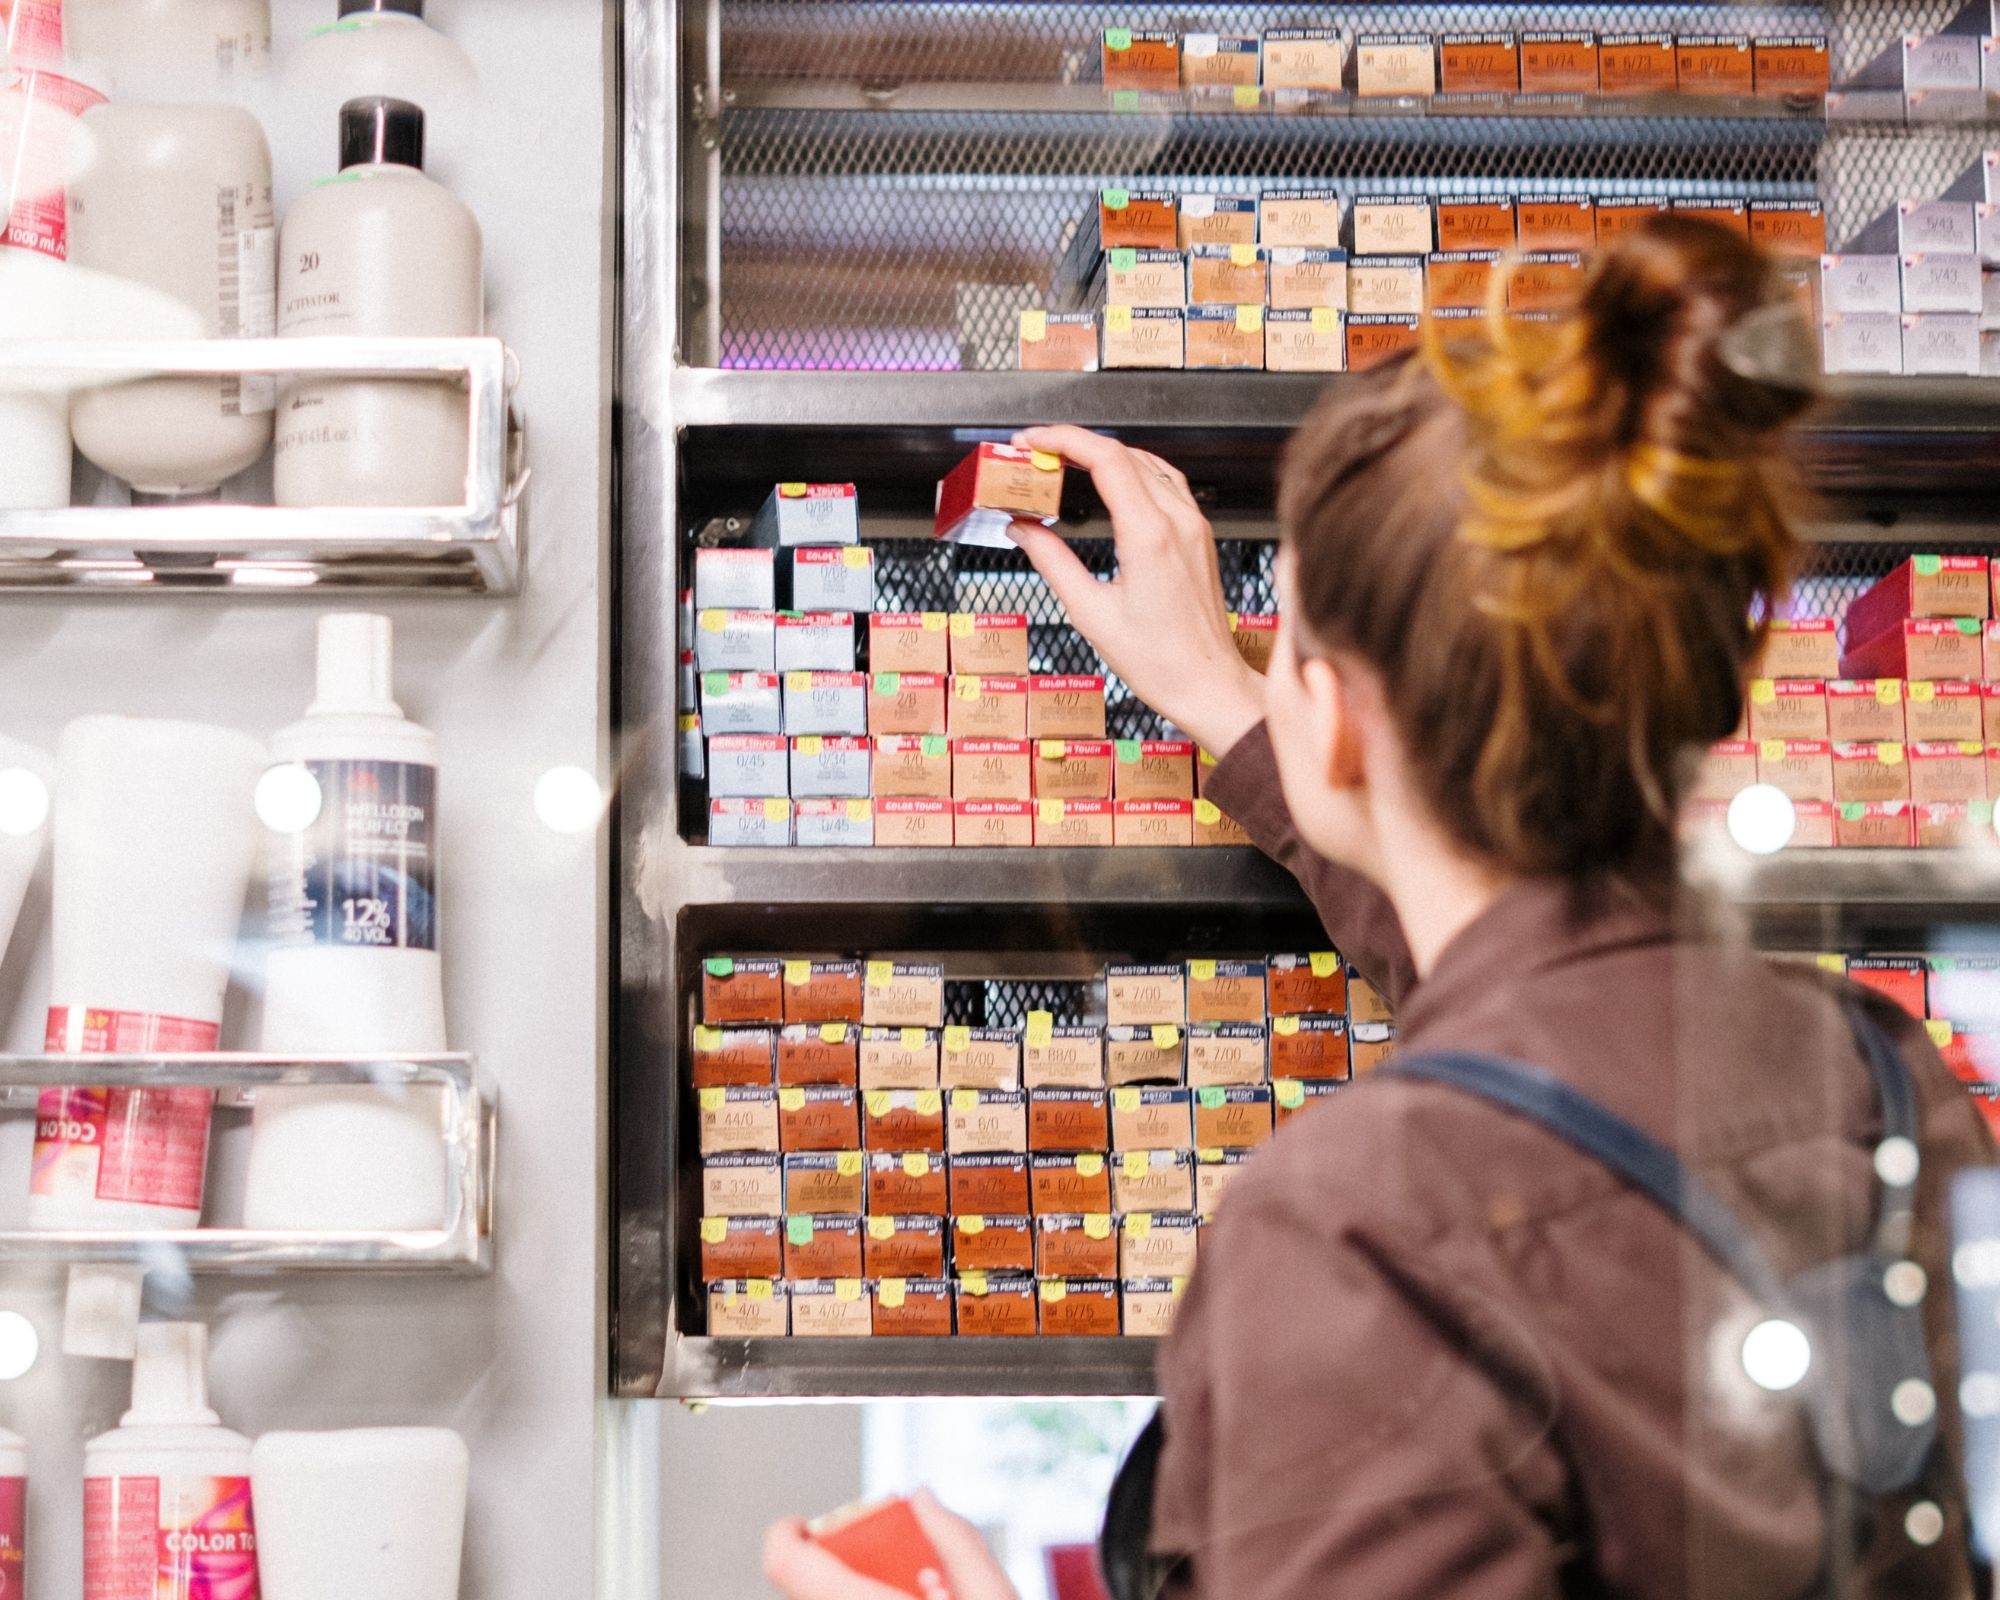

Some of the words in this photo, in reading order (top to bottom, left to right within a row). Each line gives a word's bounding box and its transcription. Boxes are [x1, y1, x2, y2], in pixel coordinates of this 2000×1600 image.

[1143, 192, 1172, 201] PERFECT
[1263, 191, 1300, 200] KOLESTON
[1303, 190, 1333, 198] PERFECT
[1358, 196, 1395, 204] KOLESTON
[1397, 195, 1427, 203] PERFECT
[1441, 195, 1479, 204] KOLESTON
[1481, 194, 1511, 203] PERFECT
[1521, 195, 1558, 204] KOLESTON
[1560, 195, 1590, 204] PERFECT
[1599, 197, 1636, 206] KOLESTON
[1638, 196, 1668, 206] PERFECT
[1674, 199, 1712, 208] KOLESTON
[1714, 199, 1745, 208] PERFECT
[1751, 201, 1788, 210] KOLESTON
[1791, 201, 1821, 211] PERFECT
[1292, 213, 1311, 226] 2/0
[1384, 214, 1404, 227] 4/0
[8, 227, 38, 247] 1000
[39, 236, 56, 253] ml
[1150, 253, 1180, 261] PERFECT
[1431, 253, 1468, 261] KOLESTON
[1470, 252, 1499, 261] PERFECT
[300, 251, 319, 273] 20
[1350, 258, 1388, 267] KOLESTON
[1389, 258, 1419, 266] PERFECT
[1150, 310, 1179, 318] PERFECT
[1269, 312, 1307, 320] KOLESTON
[1433, 308, 1469, 317] KOLESTON
[1063, 315, 1093, 323] PERFECT
[1349, 315, 1386, 324] KOLESTON
[1388, 314, 1418, 323] PERFECT
[880, 616, 904, 625] COLOR
[993, 617, 1017, 625] TOUCH
[1245, 617, 1272, 625] TOUCH
[898, 631, 918, 644] 2/0
[982, 631, 1000, 644] 3/0
[911, 677, 934, 685] TOUCH
[993, 681, 1016, 689] TOUCH
[1039, 680, 1066, 688] COLOR
[1068, 679, 1095, 688] TOUCH
[963, 742, 991, 751] COLOR
[993, 742, 1019, 751] TOUCH
[1075, 745, 1101, 753] TOUCH
[1156, 744, 1181, 752] TOUCH
[983, 756, 1002, 769] 4/0
[885, 802, 913, 811] COLOR
[915, 802, 942, 810] TOUCH
[965, 804, 992, 812] COLOR
[994, 803, 1021, 812] TOUCH
[1075, 803, 1101, 811] TOUCH
[1124, 802, 1151, 811] COLOR
[1154, 802, 1180, 810] TOUCH
[905, 816, 925, 829] 2/0
[984, 818, 1004, 831] 4/0
[343, 897, 390, 929] 12%
[748, 963, 778, 971] PERFECT
[825, 963, 855, 971] PERFECT
[909, 966, 939, 974] PERFECT
[1110, 966, 1148, 974] KOLESTON
[1150, 965, 1179, 974] PERFECT
[1313, 1020, 1343, 1029] PERFECT
[985, 1031, 1016, 1039] PERFECT
[1066, 1028, 1098, 1036] PERFECT
[1231, 1027, 1261, 1036] PERFECT
[966, 1053, 994, 1066] 6/00
[742, 1090, 773, 1099] PERFECT
[822, 1090, 853, 1098] PERFECT
[991, 1093, 1021, 1101] PERFECT
[1033, 1091, 1071, 1100] KOLESTON
[1073, 1091, 1104, 1100] PERFECT
[725, 1111, 752, 1126] 44/0
[978, 1116, 998, 1130] 6/0
[41, 1120, 97, 1144] COLOR
[706, 1157, 745, 1166] KOLESTON
[746, 1156, 777, 1165] PERFECT
[953, 1156, 991, 1165] KOLESTON
[993, 1155, 1023, 1164] PERFECT
[1034, 1158, 1071, 1167] KOLESTON
[730, 1180, 759, 1192] 33/0
[745, 1220, 776, 1229] PERFECT
[827, 1220, 857, 1228] PERFECT
[907, 1221, 937, 1229] PERFECT
[998, 1217, 1028, 1226] PERFECT
[1163, 1217, 1193, 1226] PERFECT
[915, 1284, 946, 1292] PERFECT
[1002, 1282, 1031, 1291] PERFECT
[1083, 1282, 1114, 1291] PERFECT
[739, 1304, 759, 1316] 4/0
[819, 1303, 847, 1316] 4/07
[164, 1530, 237, 1553] COLOR
